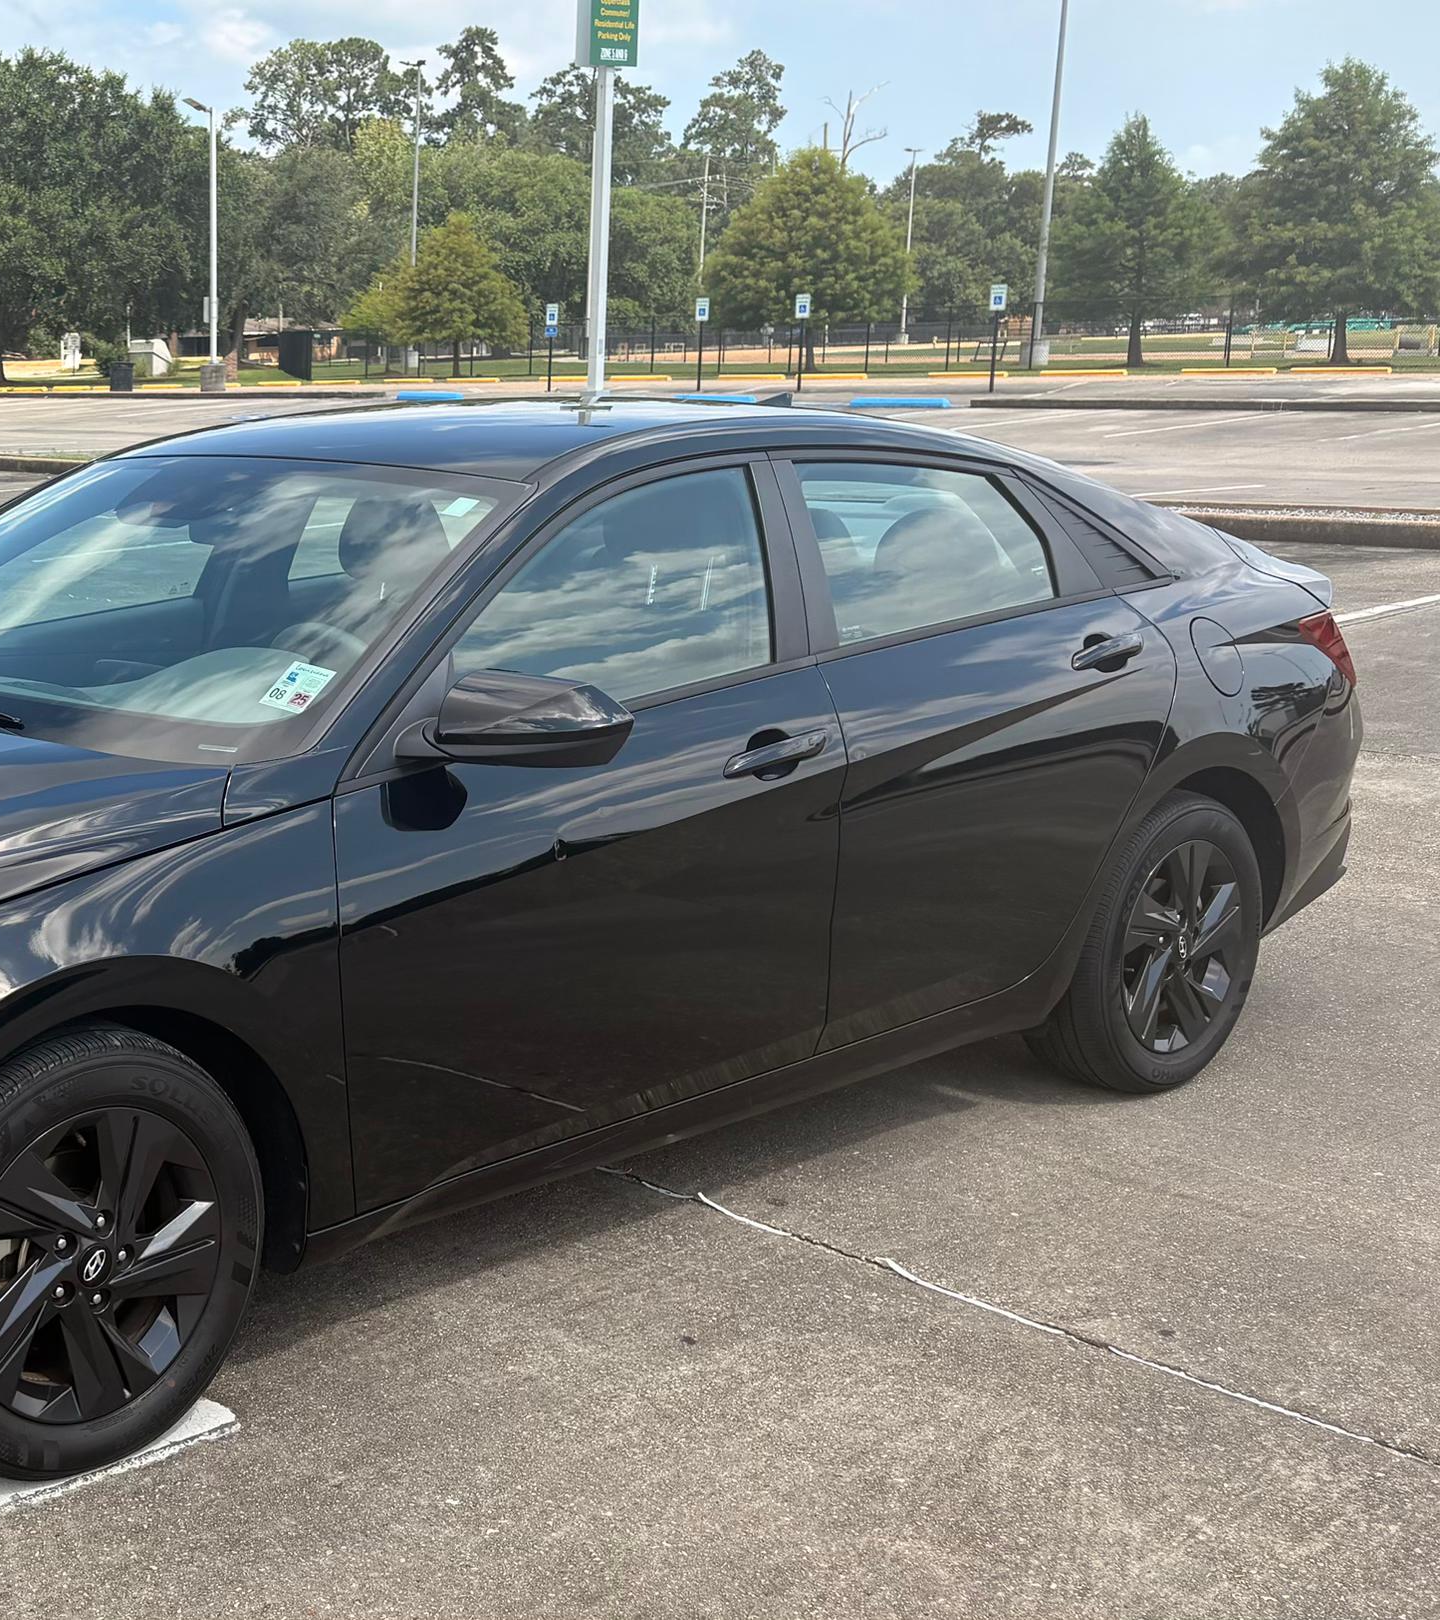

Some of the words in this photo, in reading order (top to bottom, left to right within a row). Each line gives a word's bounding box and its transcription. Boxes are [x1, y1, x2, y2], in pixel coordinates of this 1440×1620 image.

[595, 19, 624, 28] Residential
[625, 21, 635, 29] Life
[598, 31, 618, 41] Parking
[619, 32, 631, 42] Only
[269, 688, 287, 699] 08
[292, 694, 309, 705] 25
